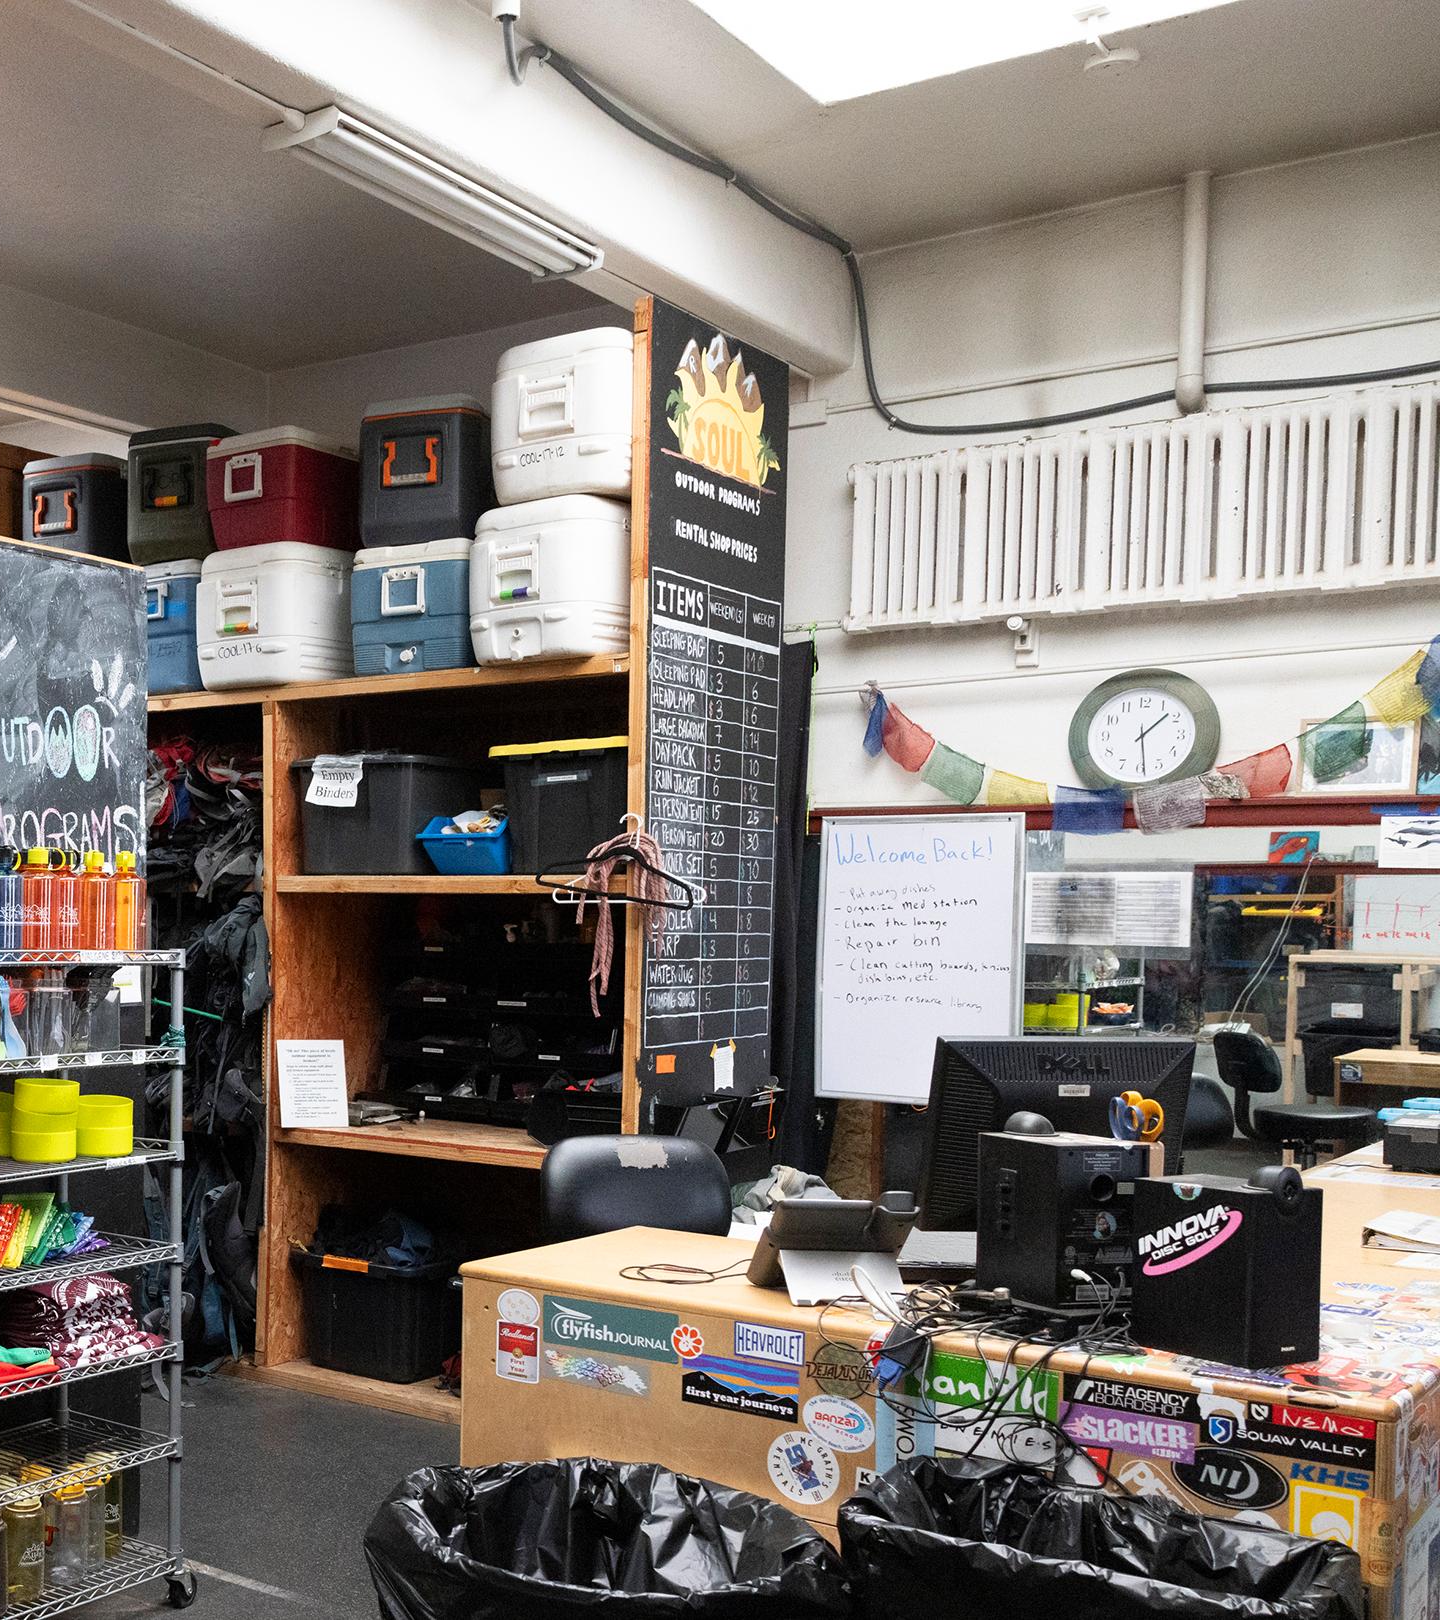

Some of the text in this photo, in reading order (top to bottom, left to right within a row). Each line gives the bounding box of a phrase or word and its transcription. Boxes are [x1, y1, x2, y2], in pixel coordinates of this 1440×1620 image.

[520, 446, 564, 467] COOL-17-12
[692, 418, 750, 481] SOUL
[675, 471, 760, 516] OUTDOOR PROGRAMS
[675, 519, 758, 563] RENTAL SHOP PRICES
[656, 580, 703, 621] ITEMS
[687, 636, 705, 658] BAG
[690, 667, 705, 688] PAD
[653, 686, 695, 713] HEADLAMP
[1122, 701, 1131, 713] 11
[1140, 697, 1151, 708] 12
[1161, 699, 1165, 711] 1
[1107, 714, 1119, 726] 10
[1172, 712, 1181, 723] 2
[1101, 731, 1110, 741] 9
[1176, 729, 1185, 740] 3
[672, 743, 696, 769] PACK
[1105, 748, 1113, 757] 8
[1169, 746, 1176, 757] 4
[1120, 758, 1127, 770] 7
[1154, 759, 1163, 769] 5
[321, 770, 355, 783] Empty
[315, 786, 354, 799] Binders
[835, 832, 993, 865] Welcome Back!
[933, 898, 978, 908] station
[885, 918, 907, 927] the
[913, 917, 948, 930] lounge
[846, 934, 941, 952] Repair bin
[678, 964, 694, 984] JUG
[849, 958, 888, 971] Clean
[1036, 1053, 1110, 1074] DELL
[1138, 1204, 1229, 1255] INNOVA
[1150, 1225, 1220, 1260] DISC GOLF
[499, 1326, 536, 1341] Redlands
[561, 1319, 670, 1351] flyfish JOURNAL
[737, 1324, 802, 1362] HEAVROLET
[510, 1358, 525, 1366] First
[685, 1386, 711, 1399] first
[712, 1391, 738, 1406] year
[740, 1395, 794, 1416] journeys
[1094, 1381, 1190, 1408] THE AGENCY
[1094, 1393, 1185, 1416] BOARDSHOP
[1282, 1409, 1364, 1436] NEMO
[800, 1436, 812, 1448] MC
[1300, 1438, 1367, 1457] VALLEY
[772, 1447, 804, 1497] RENTALS
[1290, 1462, 1370, 1491] KHS
